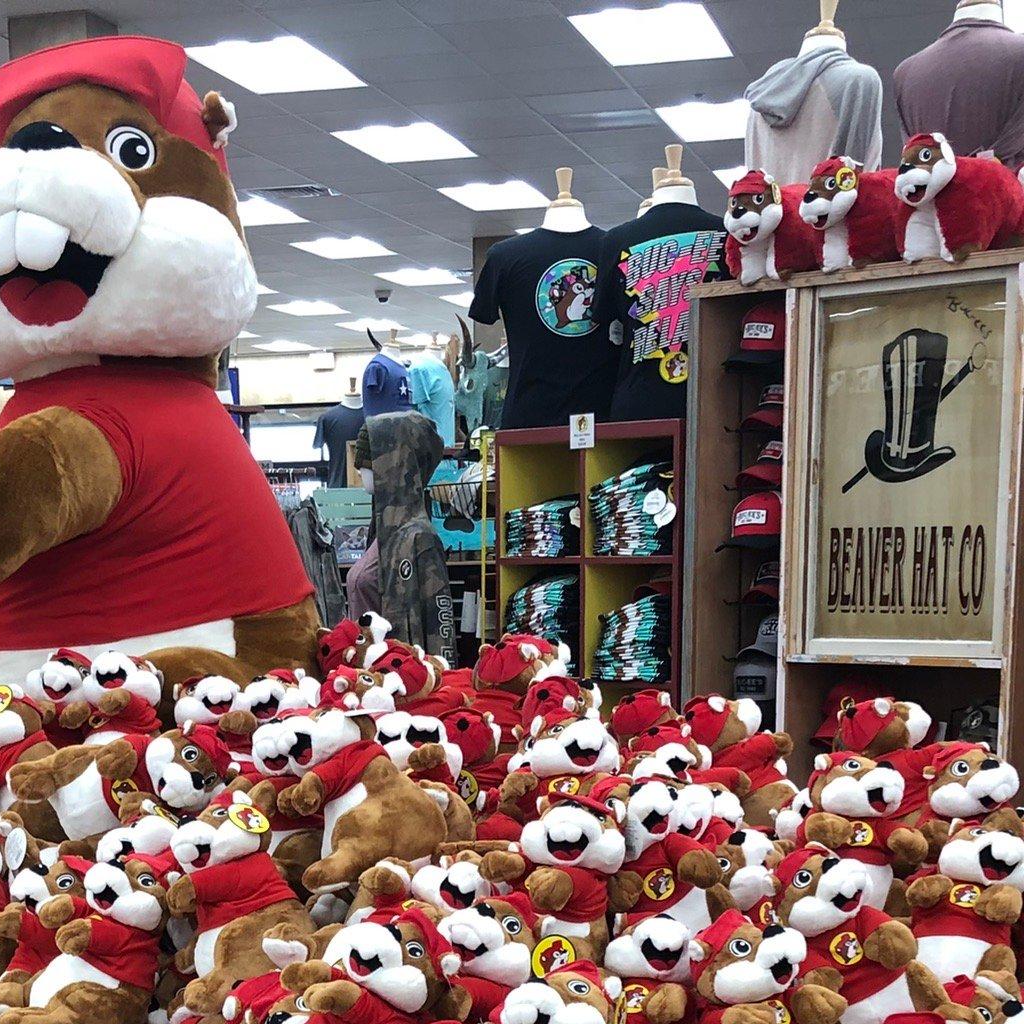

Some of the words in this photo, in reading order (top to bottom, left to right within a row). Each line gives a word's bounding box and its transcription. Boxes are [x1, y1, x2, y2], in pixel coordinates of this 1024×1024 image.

[632, 310, 690, 364] RELA
[827, 526, 906, 614] BEAVER
[910, 525, 955, 615] HAT
[958, 524, 986, 616] CO
